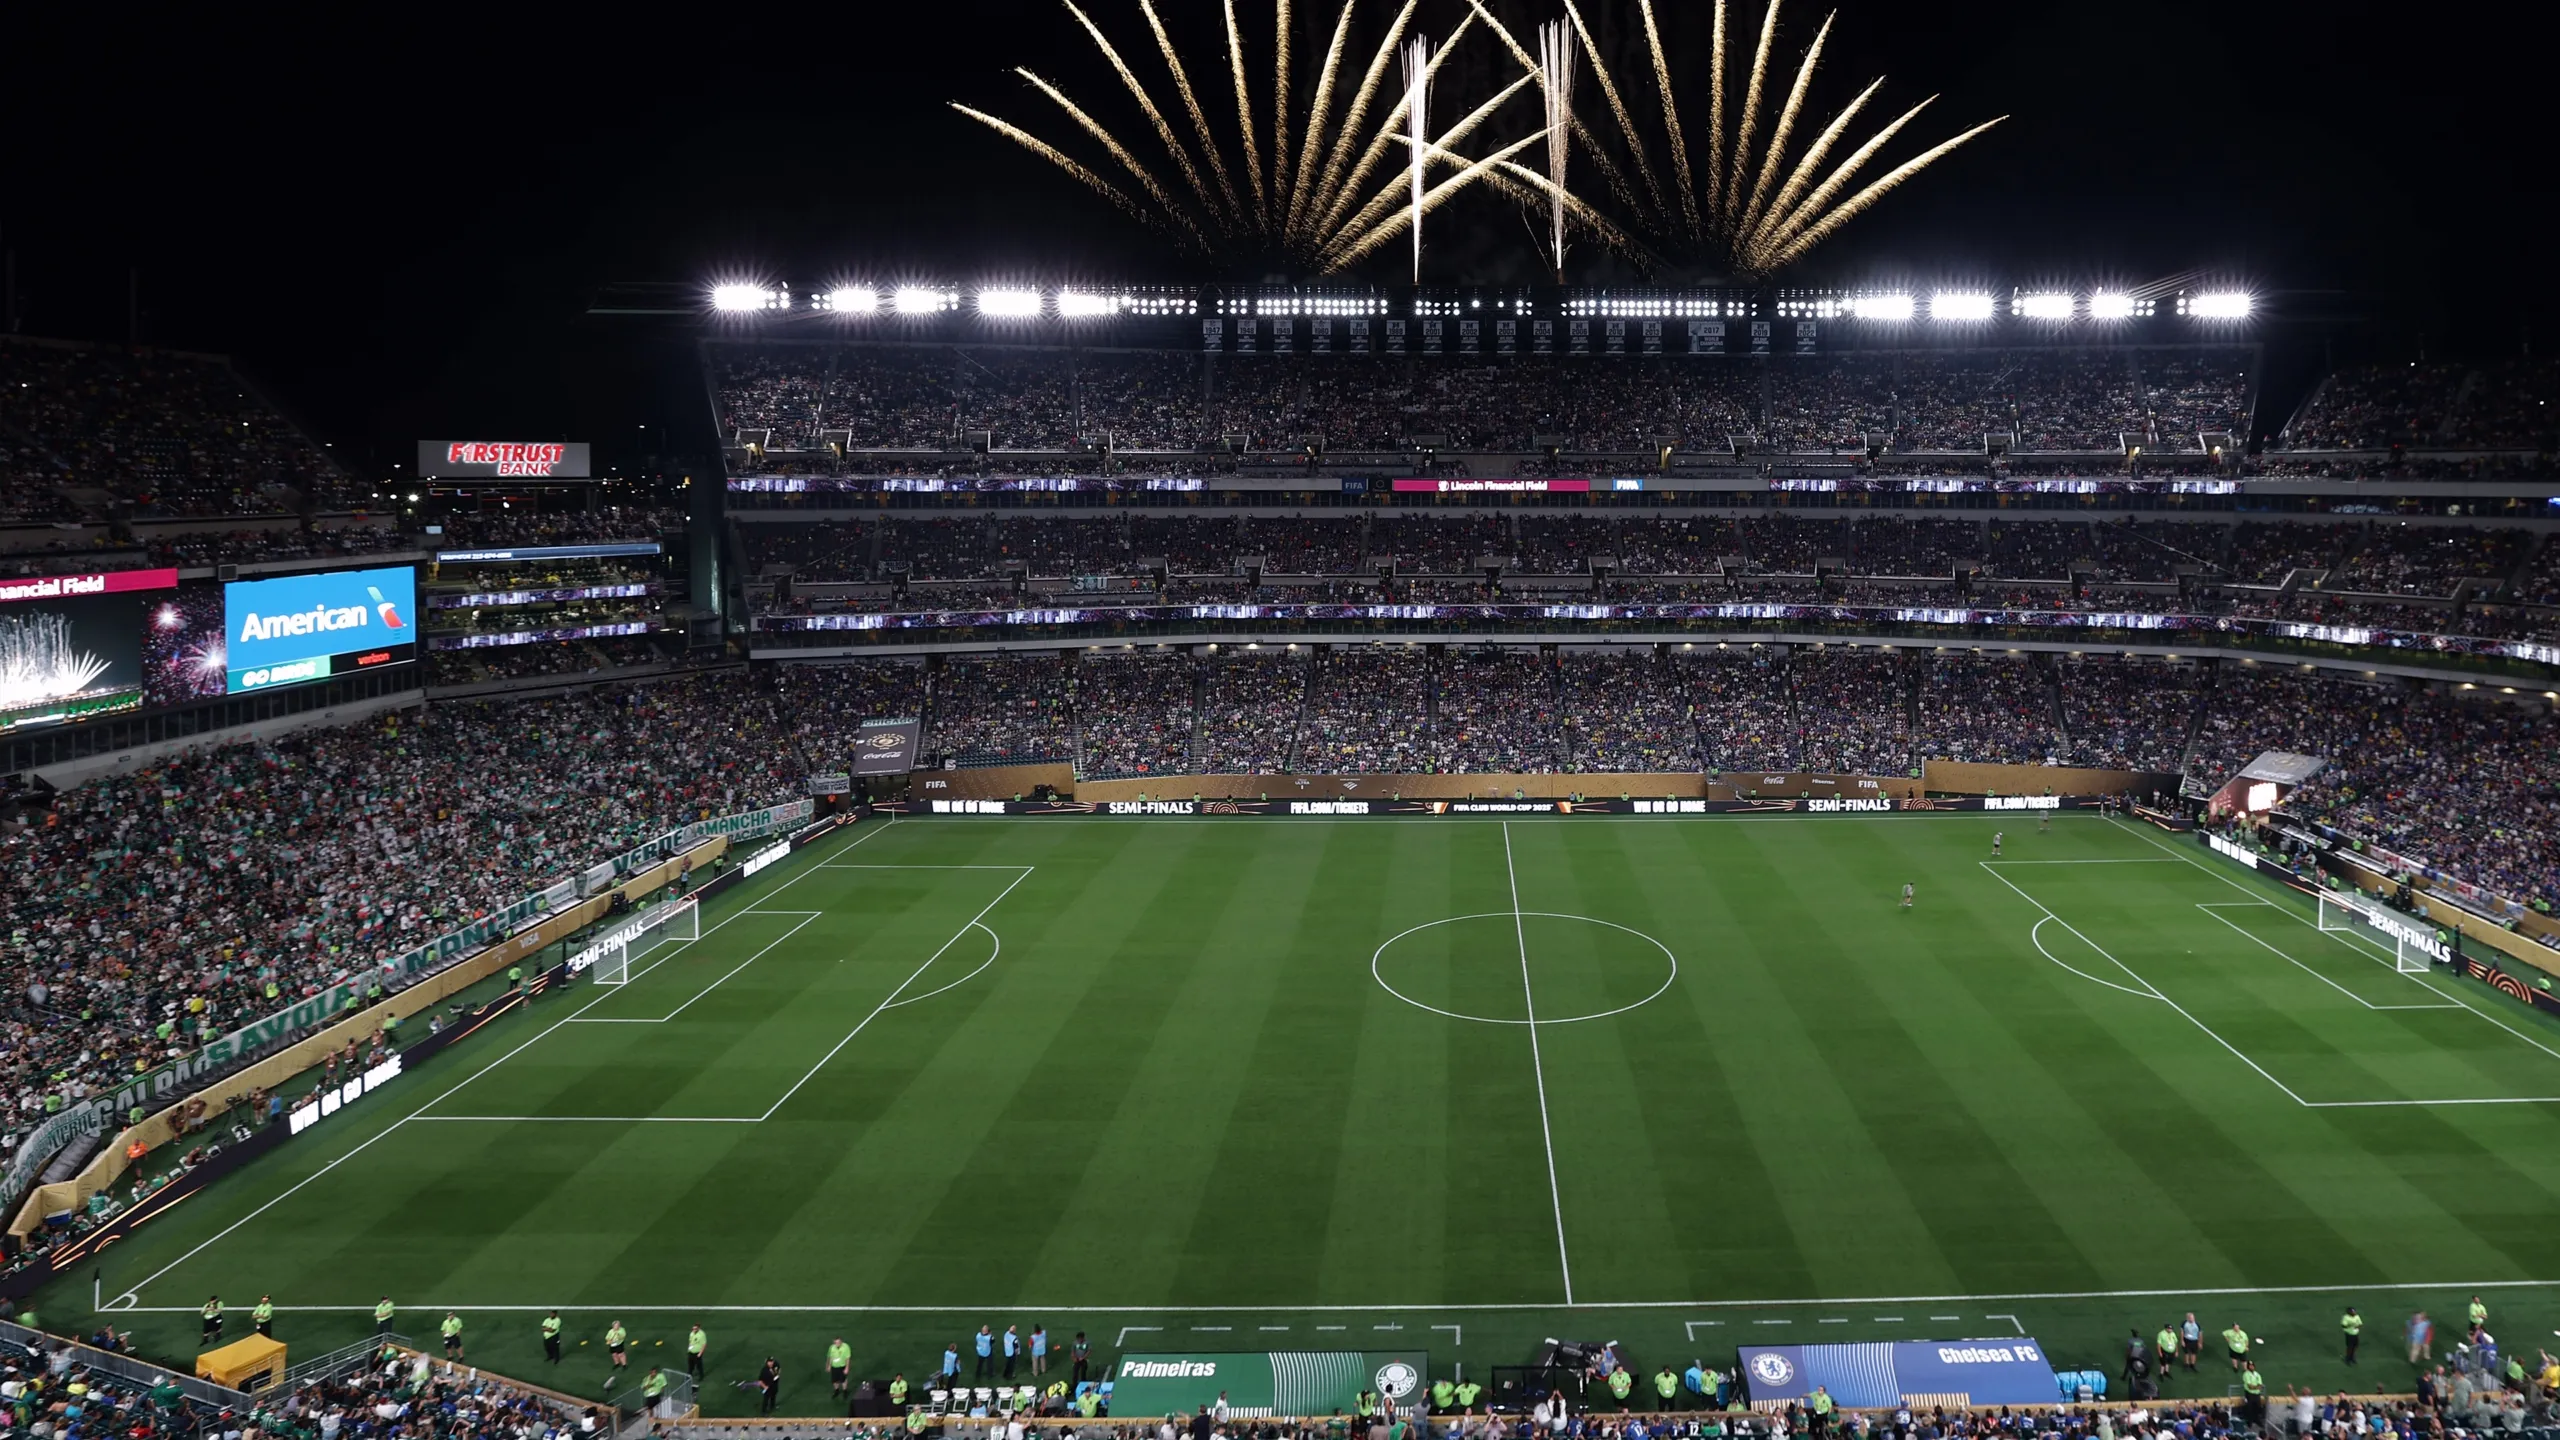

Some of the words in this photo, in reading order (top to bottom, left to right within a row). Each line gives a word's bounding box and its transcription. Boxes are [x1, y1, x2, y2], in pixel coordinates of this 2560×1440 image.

[1703, 326, 1720, 334] 2017
[497, 462, 552, 476] BANK
[1450, 480, 1484, 491] Lincoln
[1484, 480, 1524, 491] Financial
[1525, 480, 1548, 491] Field
[1616, 480, 1639, 490] FIFA
[63, 575, 104, 594] Field
[240, 604, 367, 643] American
[242, 669, 270, 687] GO
[863, 751, 903, 760] Coca-Cola
[925, 780, 947, 789] FIFA
[1763, 776, 1785, 785] Coca-Cola
[1858, 780, 1879, 789] FIFA
[773, 802, 800, 821] USA
[1109, 802, 1194, 815] SEMI-FINALS
[1290, 801, 1369, 815] FIFA.COM/TICKETS
[1808, 799, 1891, 813] SEMI-FINALS
[520, 931, 540, 949] VISA
[2367, 907, 2452, 963] SEMI-FINALS
[207, 983, 352, 1062] SAVOIA
[1938, 1347, 2014, 1364] Chelsea
[2013, 1345, 2039, 1362] FC
[1121, 1360, 1217, 1377] Palmeiras
[1689, 1424, 1699, 1434] 12
